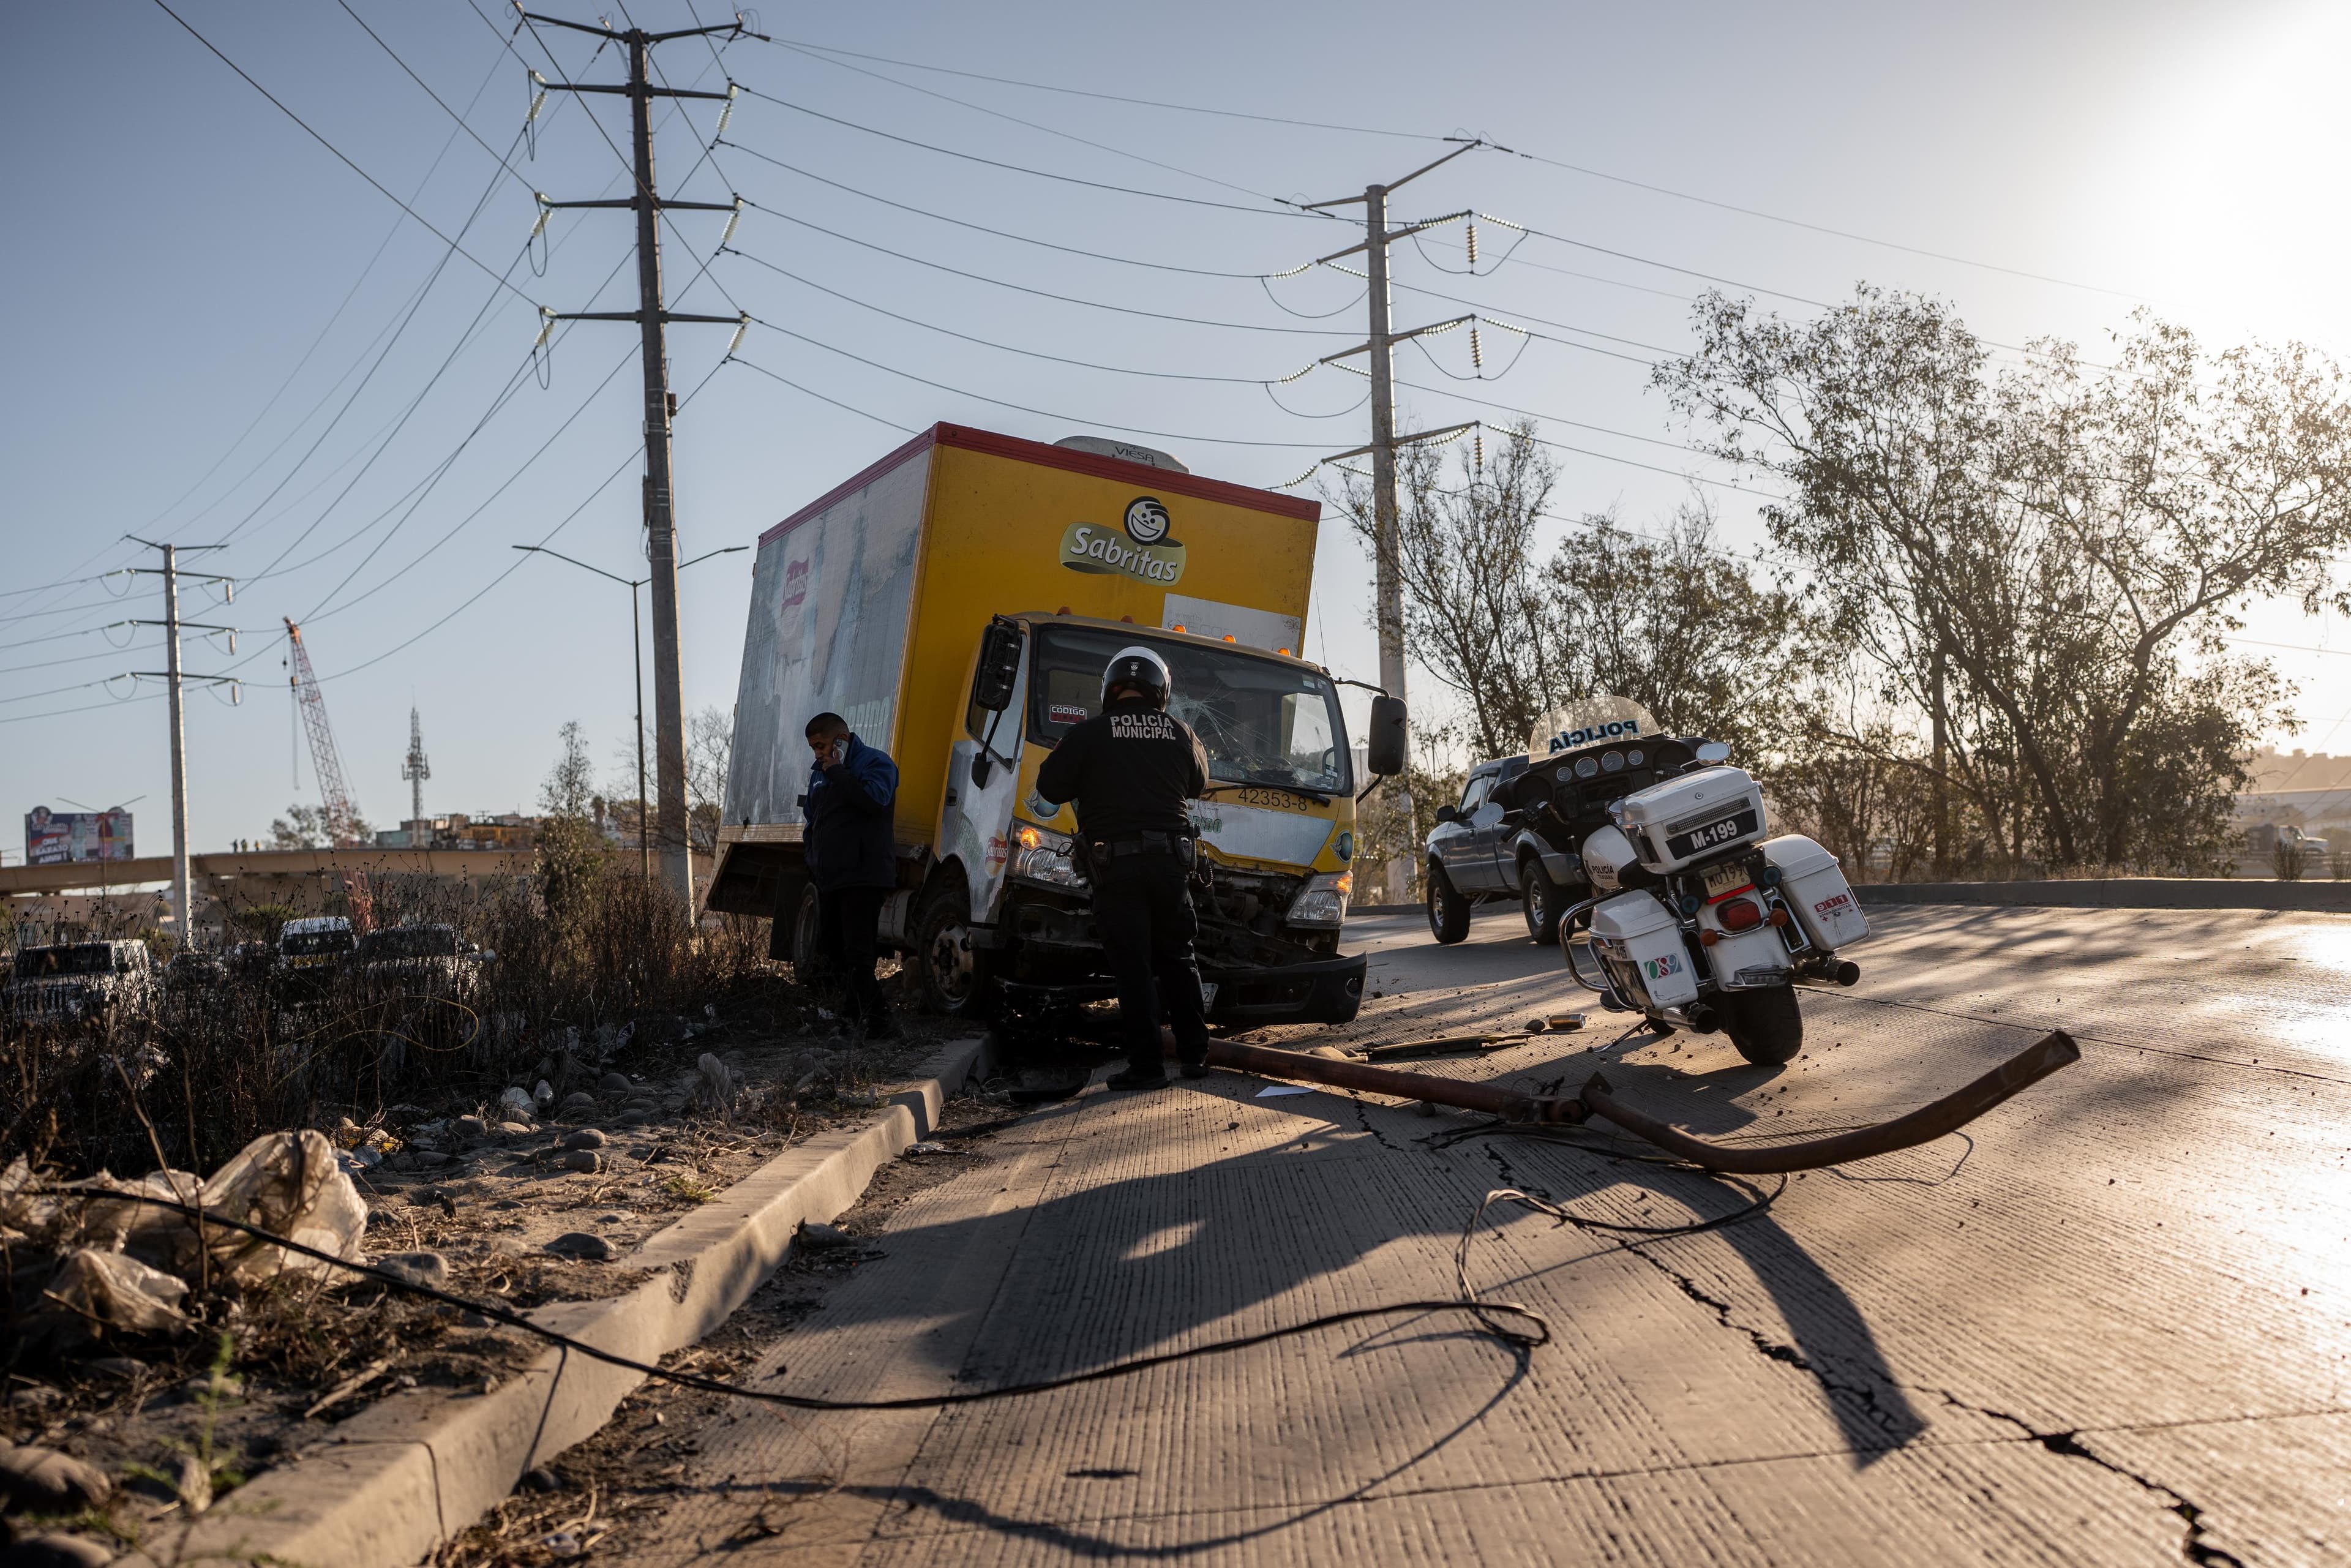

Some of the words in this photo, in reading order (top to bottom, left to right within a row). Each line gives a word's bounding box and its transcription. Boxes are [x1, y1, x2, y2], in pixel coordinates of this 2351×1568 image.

[1115, 446, 1154, 463] VIESA
[1070, 527, 1177, 582] Sabritas
[1051, 705, 1086, 716] CÓDIGO
[1109, 714, 1174, 729] POLICÍA
[1112, 726, 1176, 740] MUNICIPAL
[1238, 788, 1307, 811] 42353-8
[1690, 820, 1738, 850] M-199
[985, 842, 1008, 858] Sabritas
[1592, 863, 1614, 874] POLICÍA
[1817, 896, 1845, 911] 911
[1648, 953, 1679, 981] 089
